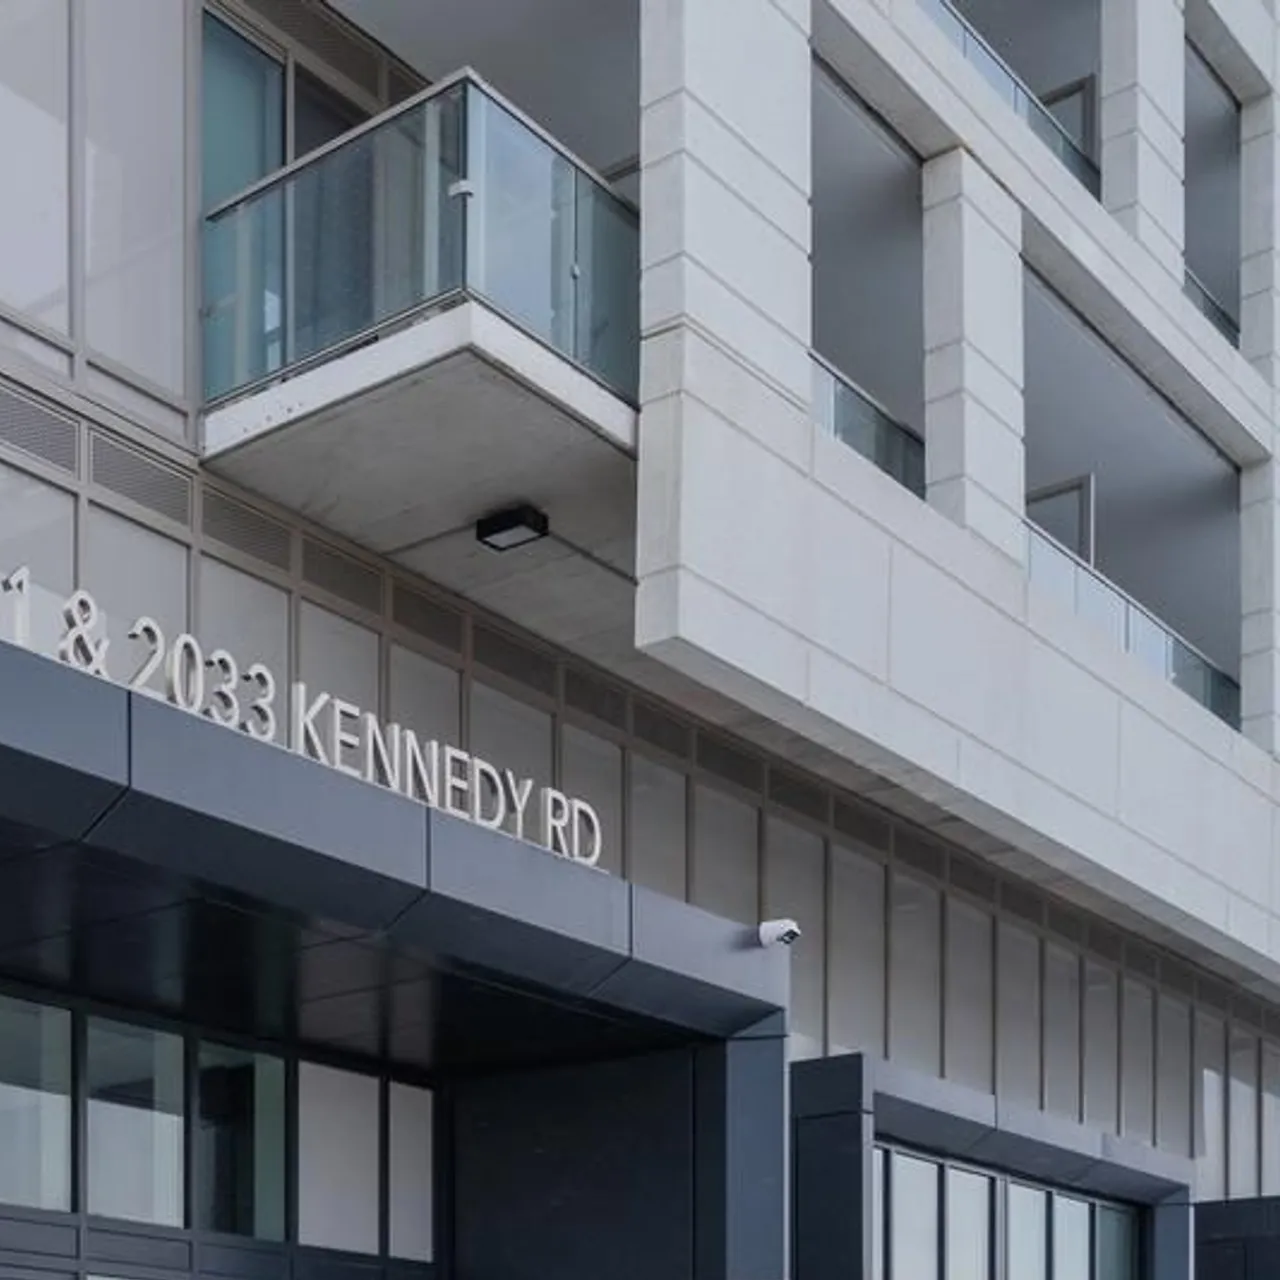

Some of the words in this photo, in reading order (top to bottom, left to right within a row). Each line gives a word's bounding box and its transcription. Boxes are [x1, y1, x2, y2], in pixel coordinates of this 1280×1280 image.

[60, 589, 110, 677] &
[128, 616, 276, 743] 2033
[292, 682, 533, 838] KENNEDY
[542, 787, 603, 866] RD
